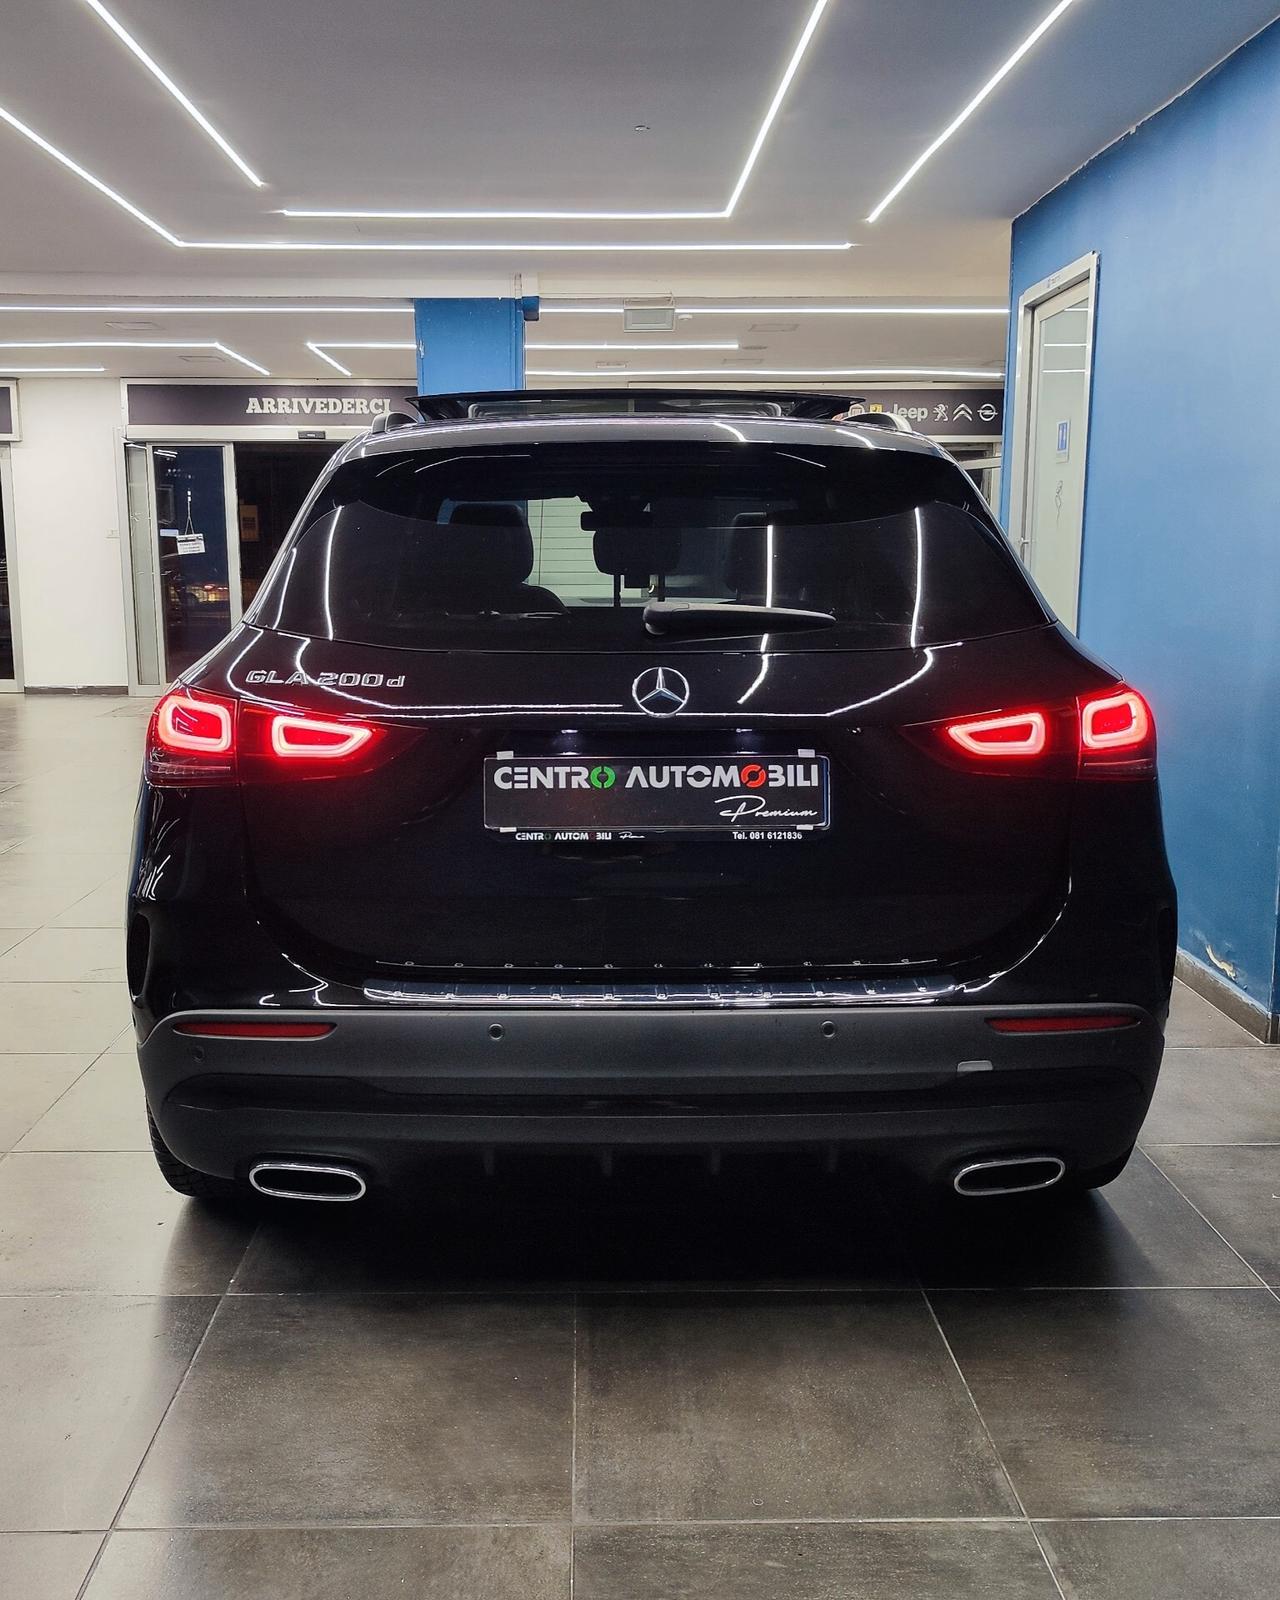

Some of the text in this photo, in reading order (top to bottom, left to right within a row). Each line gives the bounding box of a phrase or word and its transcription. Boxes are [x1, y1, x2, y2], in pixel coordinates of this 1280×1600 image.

[246, 398, 391, 414] ARRIVEDERCI
[892, 404, 929, 422] Jeep
[245, 670, 309, 686] GLA
[493, 763, 819, 790] CENTRO AUTOMOBILI
[714, 795, 818, 822] Premium
[732, 831, 803, 840] Tel. 081 6121836
